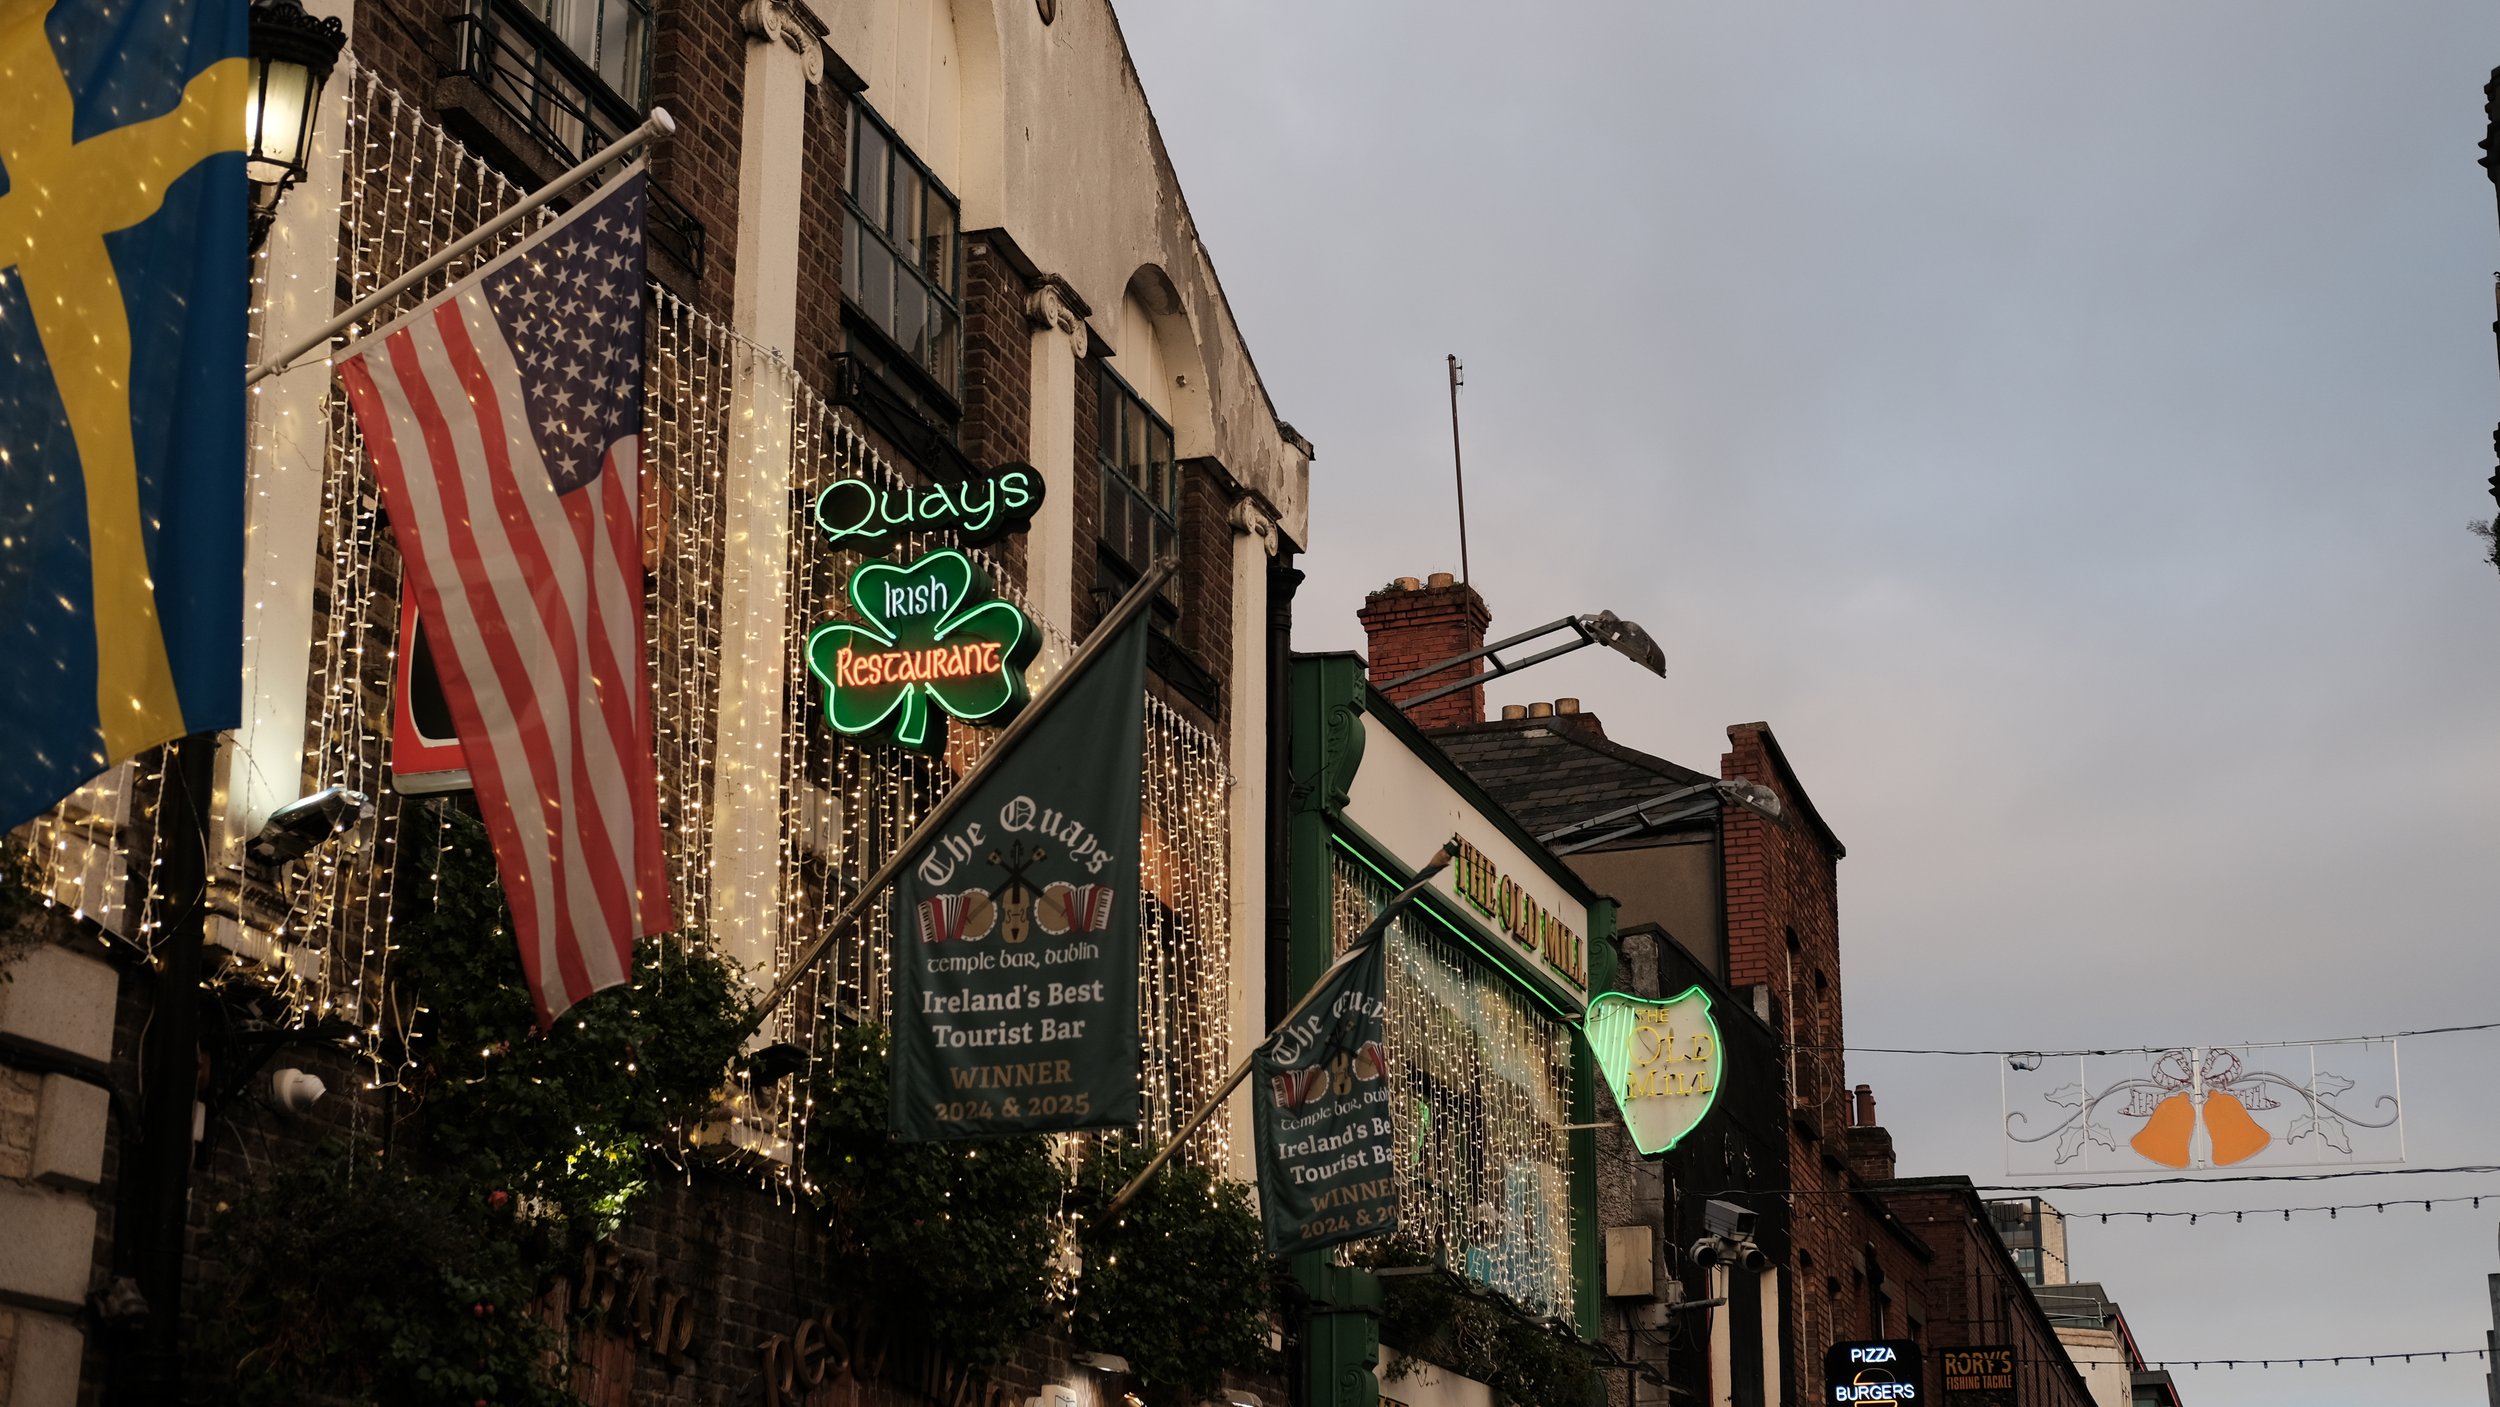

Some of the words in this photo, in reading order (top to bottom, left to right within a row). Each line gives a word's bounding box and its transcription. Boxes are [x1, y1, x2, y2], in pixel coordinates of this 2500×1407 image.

[815, 472, 1030, 541] Quays
[918, 822, 986, 887] The
[999, 795, 1114, 875] Quays
[1455, 832, 1497, 918] THE
[1500, 874, 1540, 951] OLD
[1542, 907, 1587, 992] MILL
[922, 984, 1041, 1014] Ireland's
[1047, 979, 1105, 1007] Best
[1636, 1008, 1670, 1024] THE
[932, 1020, 1033, 1048] Tourist
[1039, 1018, 1086, 1042] Bar
[1271, 1014, 1324, 1065] The
[949, 1059, 1073, 1090] WINNER
[934, 1099, 995, 1121] 2024
[1001, 1096, 1021, 1118] &
[1028, 1091, 1090, 1117] 2025
[1279, 1123, 1368, 1160] Ireland's
[1371, 1117, 1392, 1137] Be
[1290, 1150, 1369, 1185] Tourist
[1372, 1144, 1394, 1165] Ba
[1299, 1215, 1351, 1239] 2024
[1355, 1208, 1373, 1227] &
[1376, 1205, 1396, 1222] 20
[1851, 1347, 1897, 1364] PIZZA
[1945, 1351, 2012, 1376] RORY'S
[1836, 1384, 1915, 1402] BURGERS
[1946, 1375, 1980, 1391] FISHING
[1982, 1374, 2013, 1390] TACKLE
